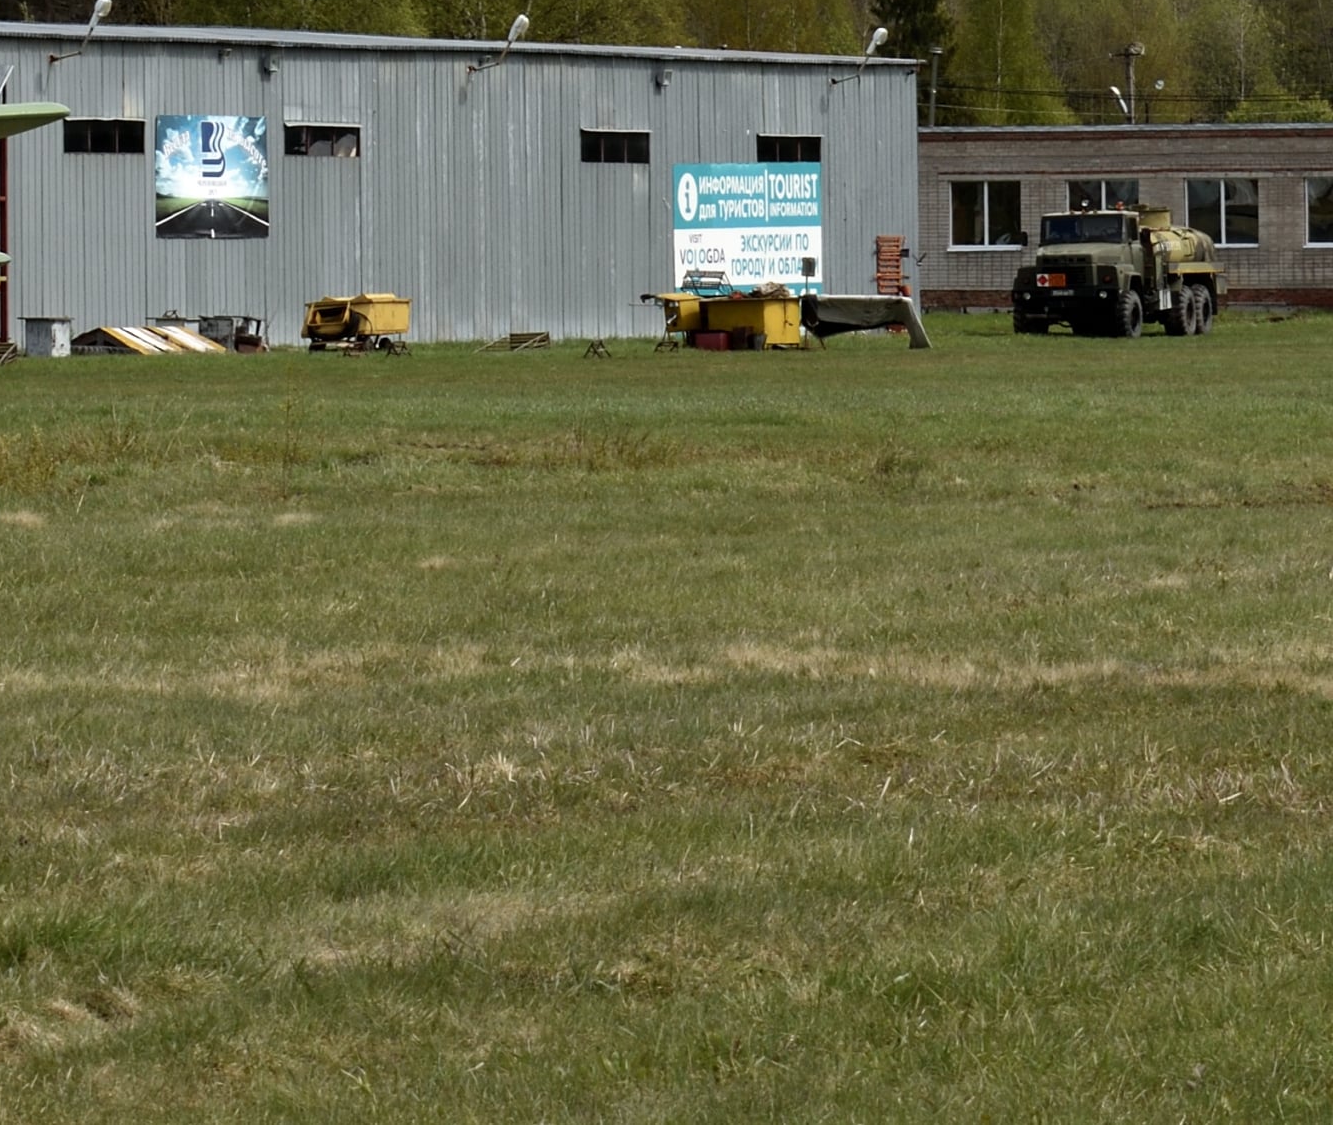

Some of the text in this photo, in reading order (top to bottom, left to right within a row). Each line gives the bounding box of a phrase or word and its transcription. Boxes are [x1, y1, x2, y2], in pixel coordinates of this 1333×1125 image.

[699, 176, 764, 197] ИНФОРМАЦИЯ
[769, 174, 818, 199] TOURIST
[699, 199, 765, 221] для ТУРИСТОВ
[769, 202, 818, 217] INFORMATION
[740, 233, 809, 254] ЭКСКУРСИИ ПО
[731, 258, 766, 278] ГОРОДУ
[768, 258, 775, 275] И
